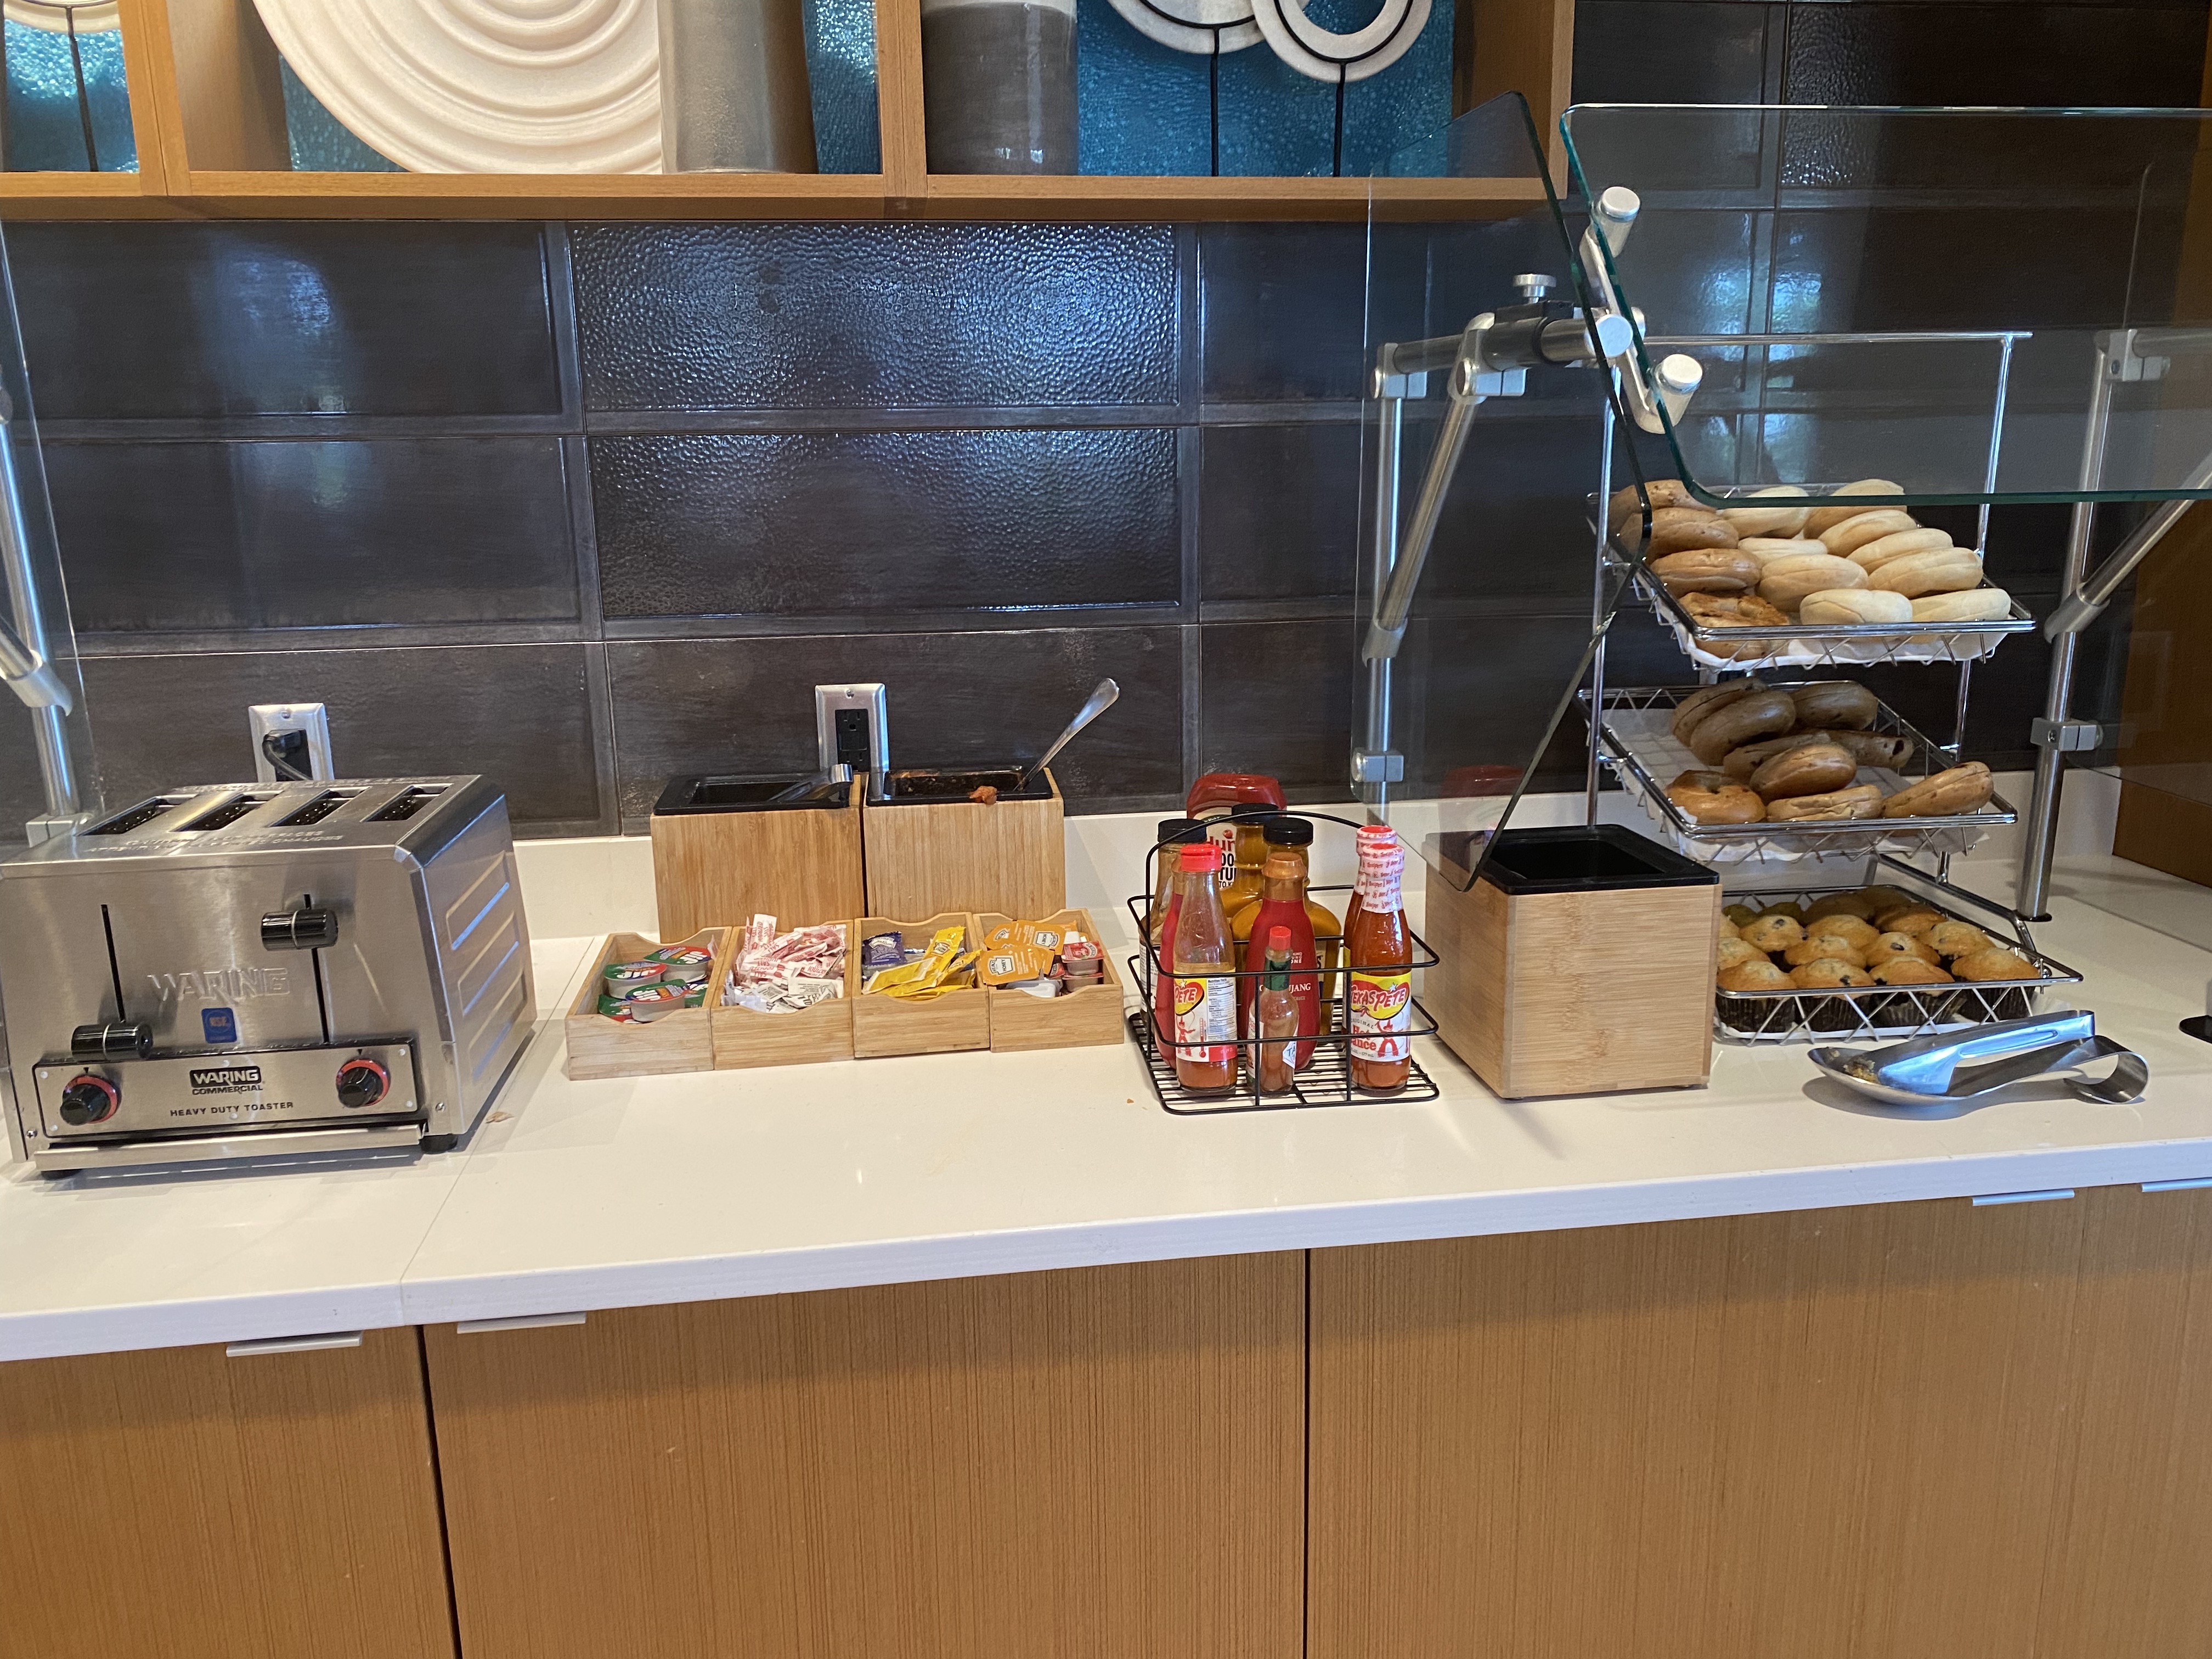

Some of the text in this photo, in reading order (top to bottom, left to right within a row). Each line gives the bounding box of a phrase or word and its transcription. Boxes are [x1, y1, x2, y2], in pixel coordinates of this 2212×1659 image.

[146, 968, 290, 1005] WARING
[1373, 989, 1406, 1012] PETE
[1352, 1038, 1376, 1051] auce
[193, 1069, 259, 1086] WARING
[192, 1085, 263, 1095] COMMERCIAL
[170, 1102, 294, 1117] HEAVY DUTY TOASTER
